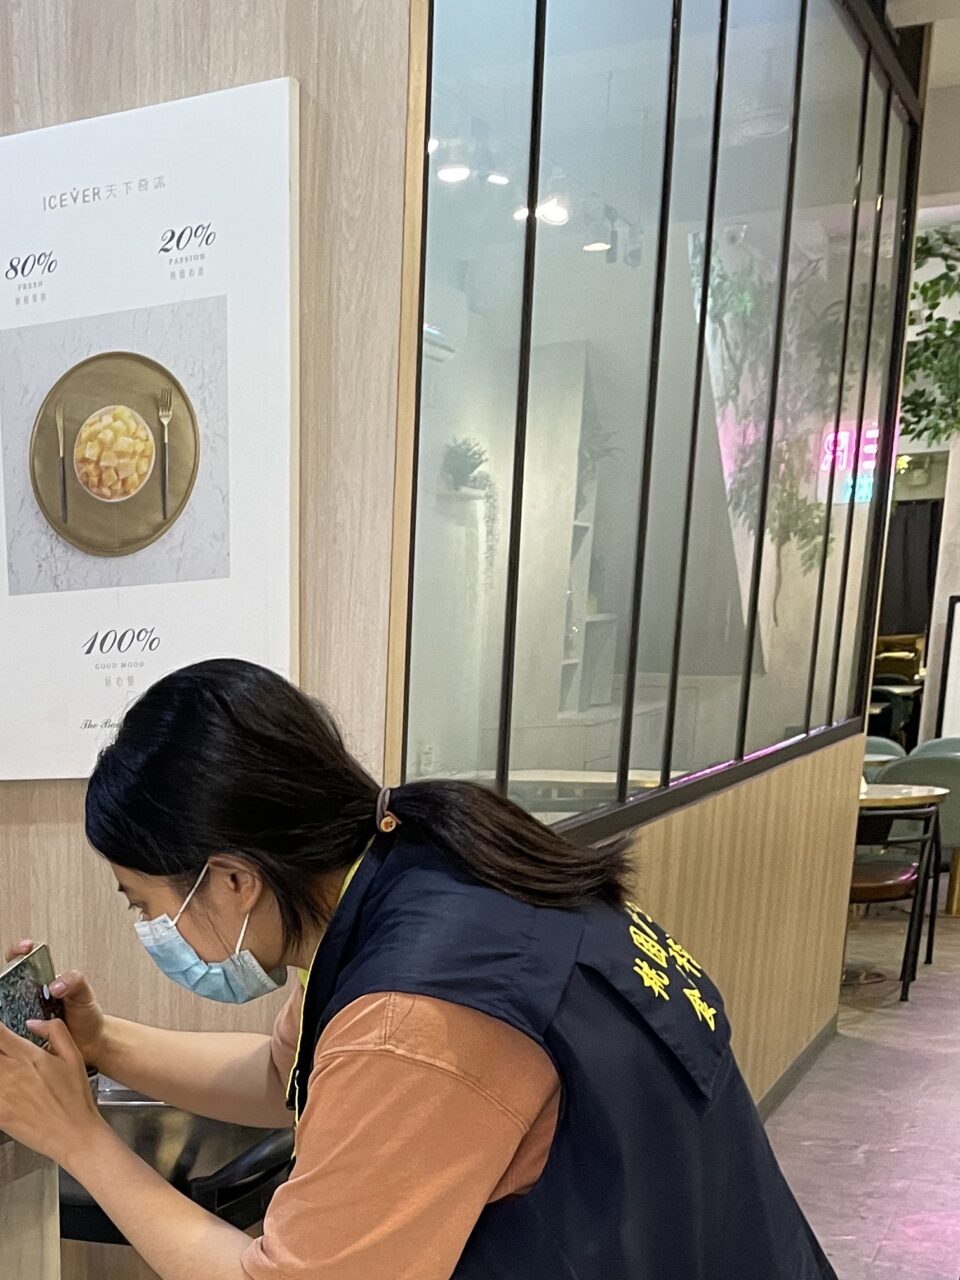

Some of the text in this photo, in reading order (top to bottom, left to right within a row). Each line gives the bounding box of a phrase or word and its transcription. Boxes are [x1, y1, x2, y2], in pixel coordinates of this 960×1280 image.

[158, 222, 216, 254] 20%
[5, 250, 58, 280] 80%
[81, 627, 161, 655] 100%
